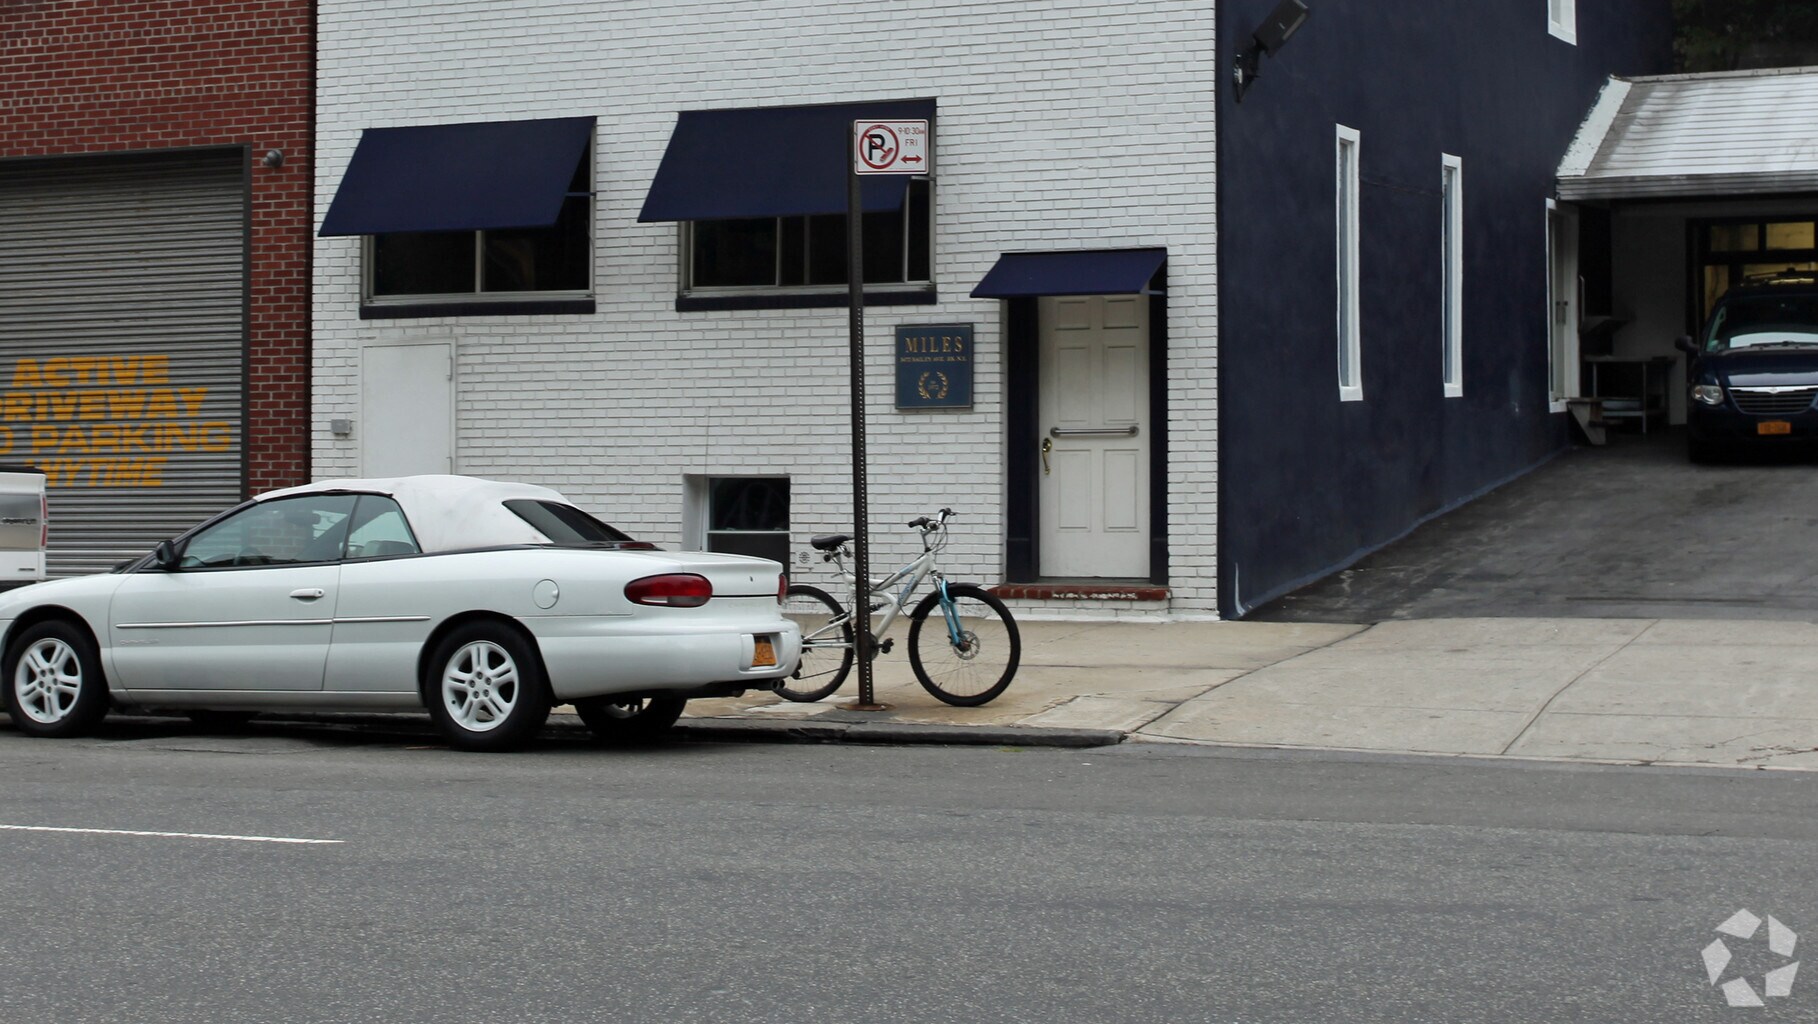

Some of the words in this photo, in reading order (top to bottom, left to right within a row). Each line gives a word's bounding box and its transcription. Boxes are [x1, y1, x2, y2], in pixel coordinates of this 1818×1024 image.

[905, 138, 918, 146] FRI
[904, 336, 963, 353] MILES
[12, 355, 169, 387] ACTIVE
[0, 387, 208, 421] RIVEWAY
[32, 421, 232, 454] PARKING
